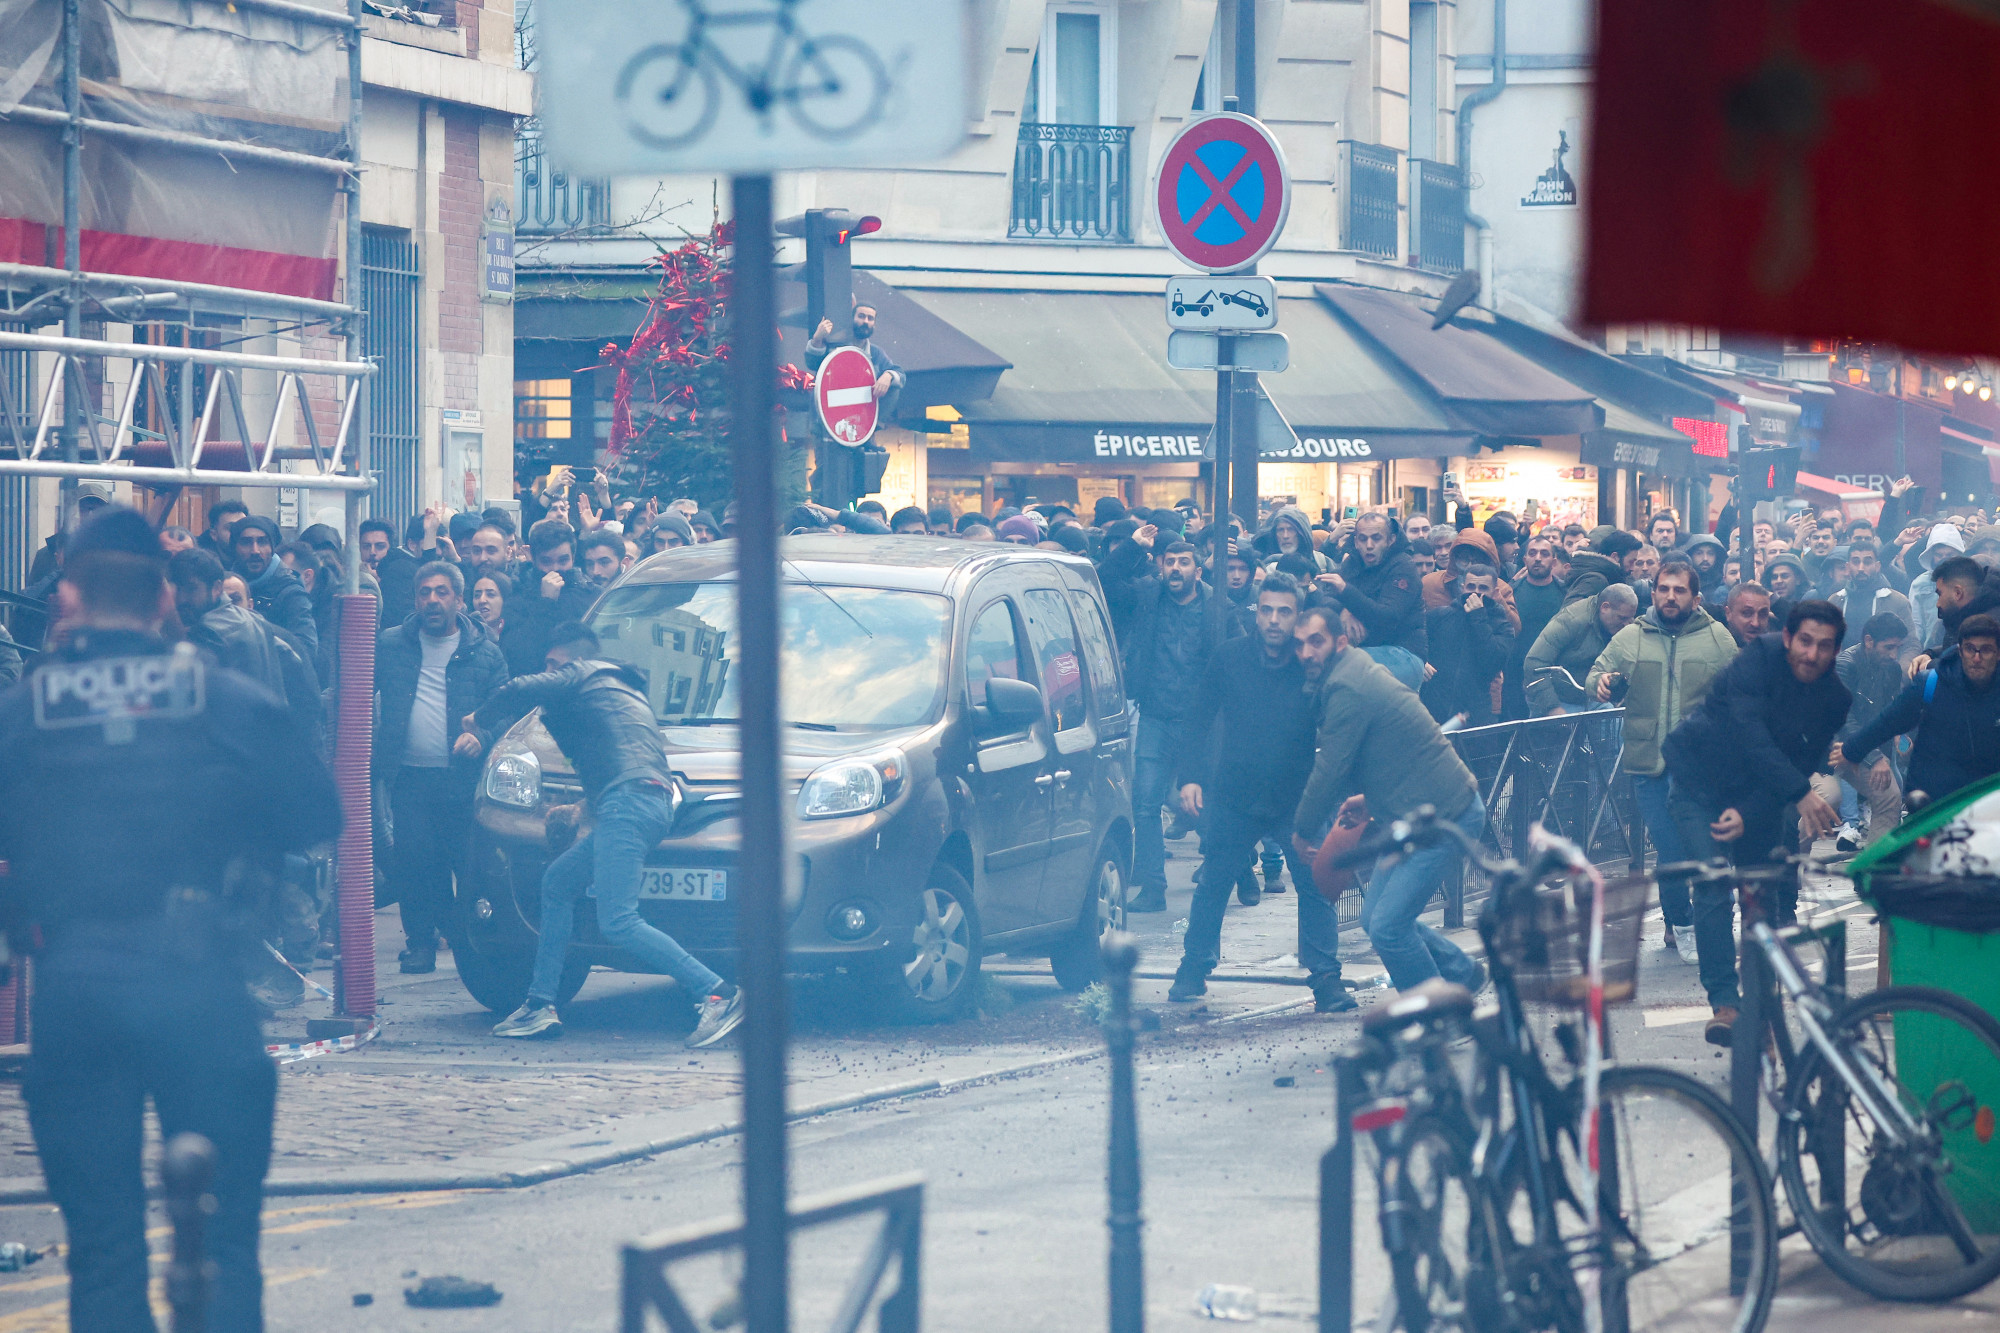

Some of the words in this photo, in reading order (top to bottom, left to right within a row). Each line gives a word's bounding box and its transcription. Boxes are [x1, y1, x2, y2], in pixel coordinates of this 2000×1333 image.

[1536, 181, 1565, 192] OHN
[1525, 192, 1572, 203] HAMON
[496, 238, 505, 251] RUE
[496, 271, 510, 286] DENIS
[1093, 430, 1202, 457] ÉPICERIE
[46, 661, 180, 704] POLIC
